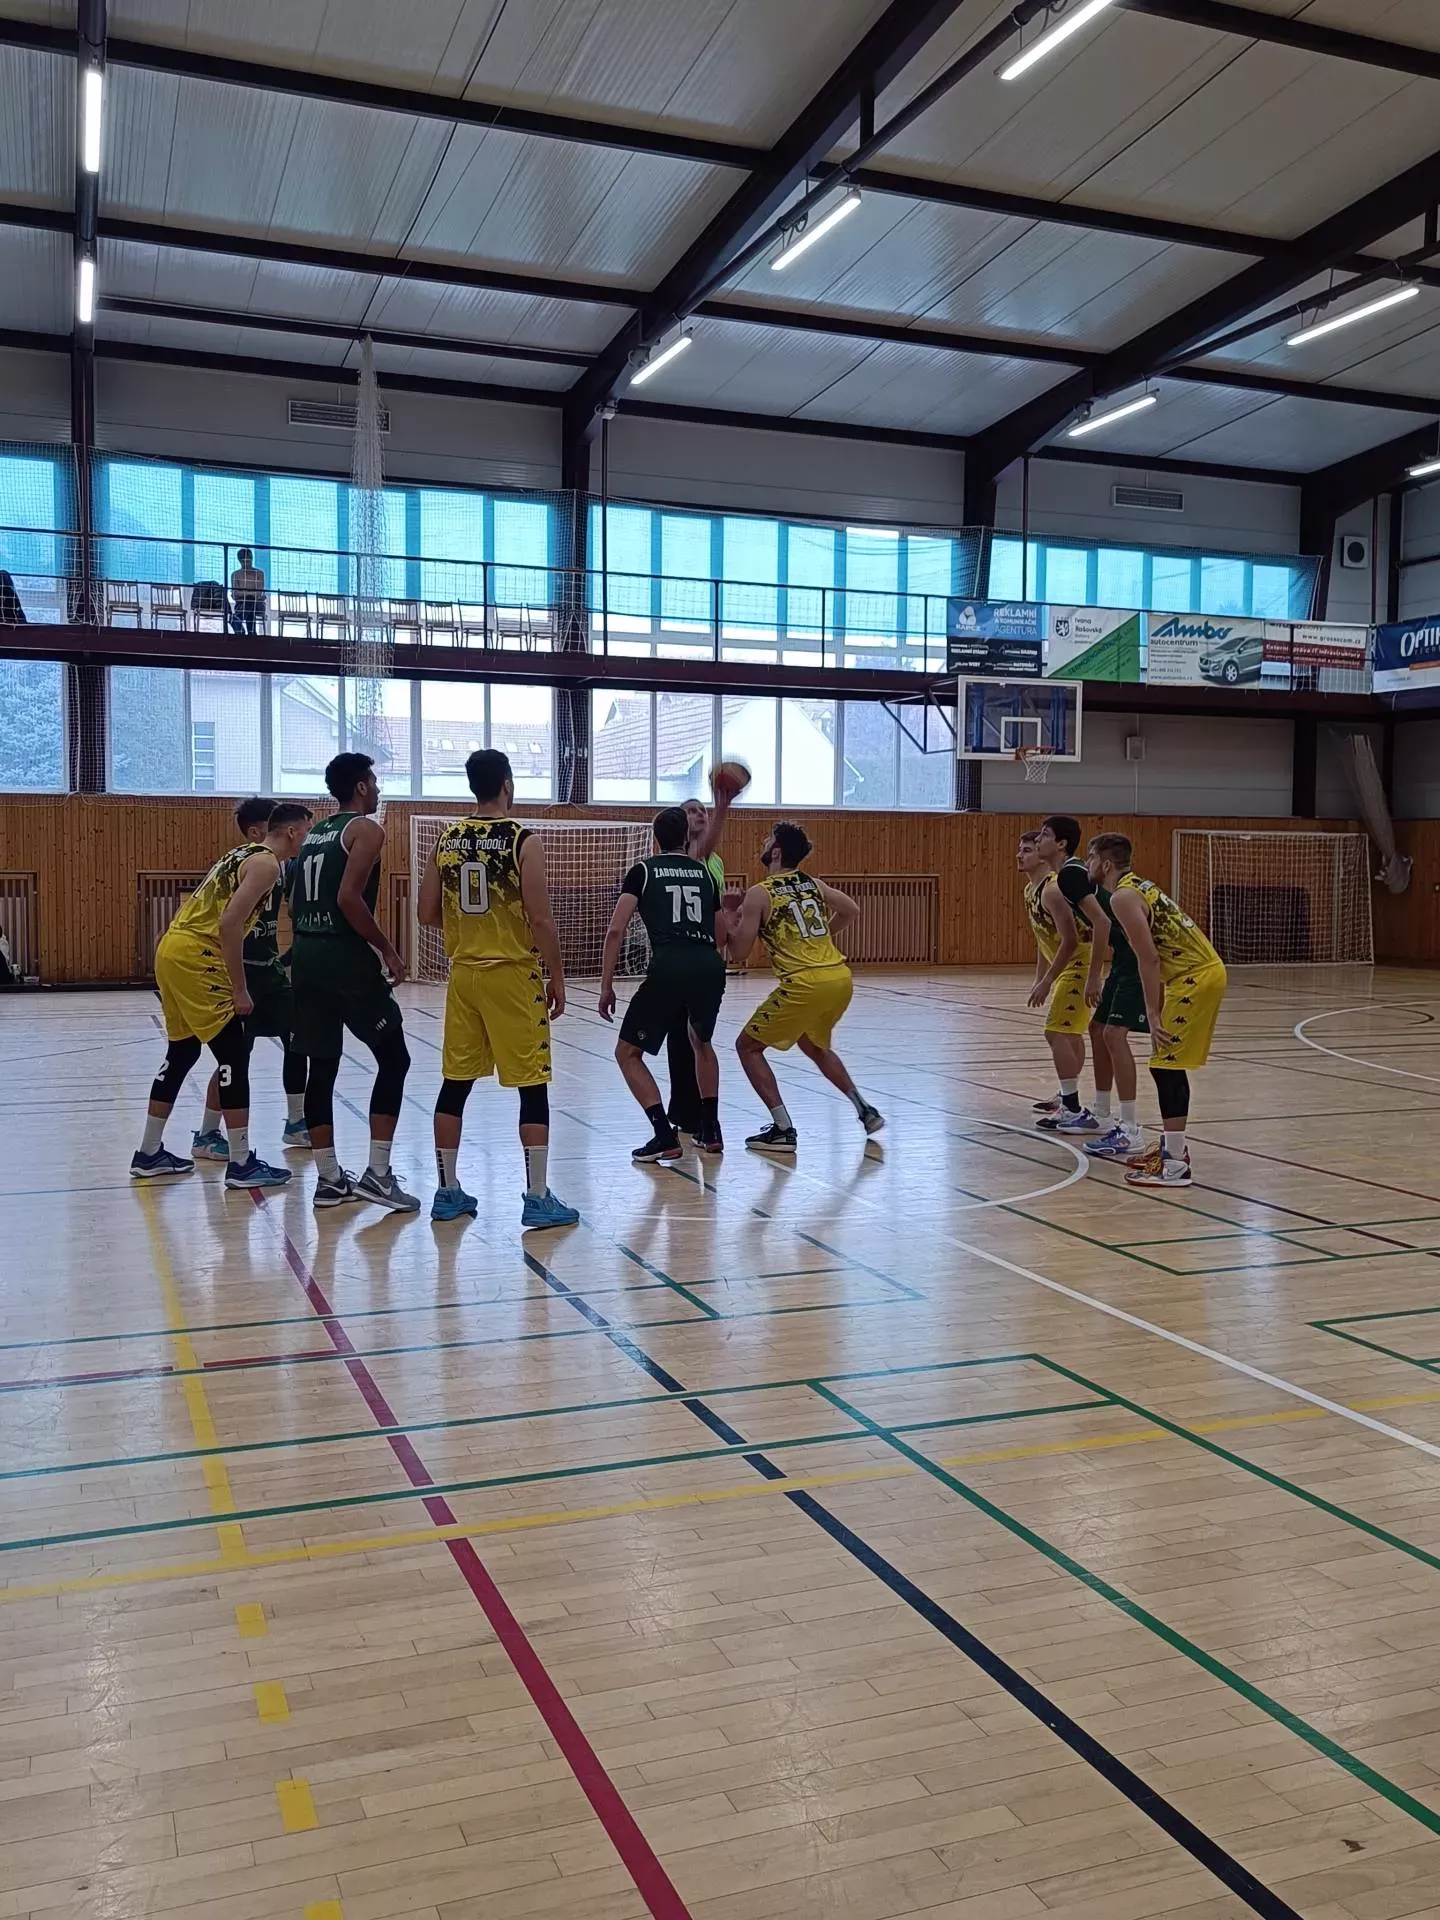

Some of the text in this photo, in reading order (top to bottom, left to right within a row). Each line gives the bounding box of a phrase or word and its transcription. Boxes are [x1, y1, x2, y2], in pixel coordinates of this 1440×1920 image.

[1150, 639, 1199, 647] autocentrum
[446, 838, 473, 850] SOKOL
[460, 861, 490, 914] 0
[665, 885, 702, 924] 75
[788, 899, 828, 938] 13
[219, 1064, 232, 1087] 3
